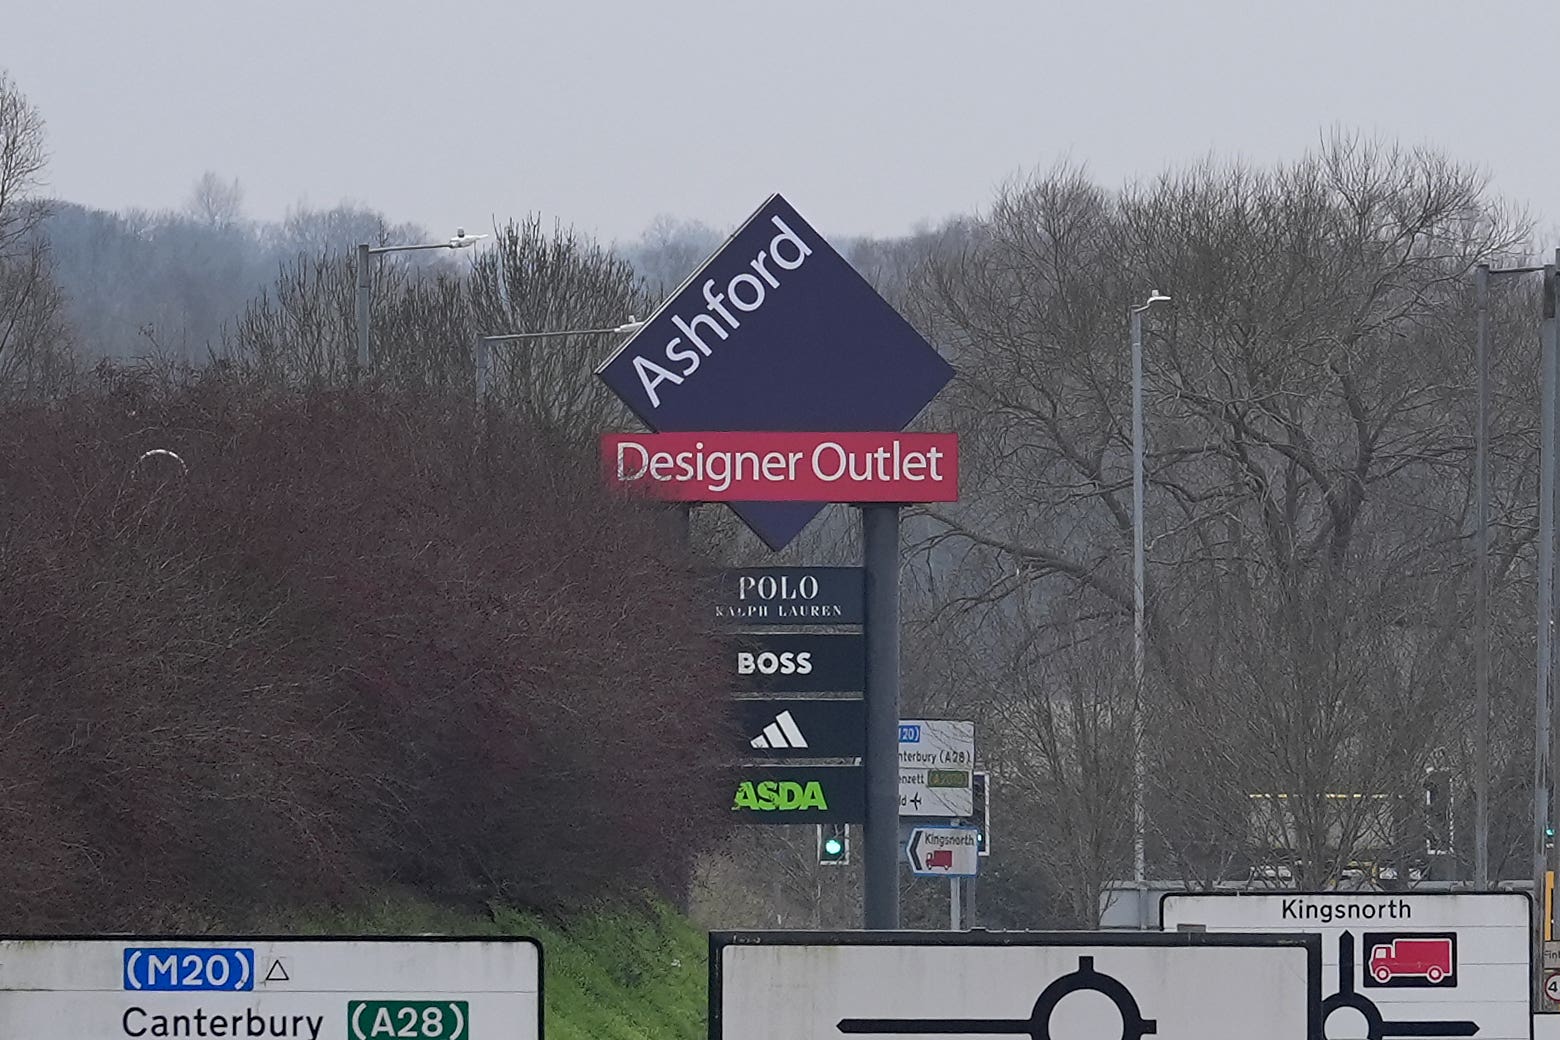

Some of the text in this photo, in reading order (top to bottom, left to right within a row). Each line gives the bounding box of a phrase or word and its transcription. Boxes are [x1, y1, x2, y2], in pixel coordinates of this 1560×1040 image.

[632, 215, 813, 408] Ashford
[617, 440, 943, 492] Designer Outlet
[739, 575, 819, 600] POLO
[715, 605, 842, 617] RALPH LAUREN
[737, 652, 813, 675] BOSS
[899, 726, 920, 742] 20)
[940, 750, 970, 763] (A28)
[732, 781, 828, 811] ASDA
[925, 832, 975, 847] Kingsnorth
[1282, 899, 1411, 923] Kingsnorth
[126, 950, 252, 990] (M20)
[351, 1002, 465, 1040] (A28)
